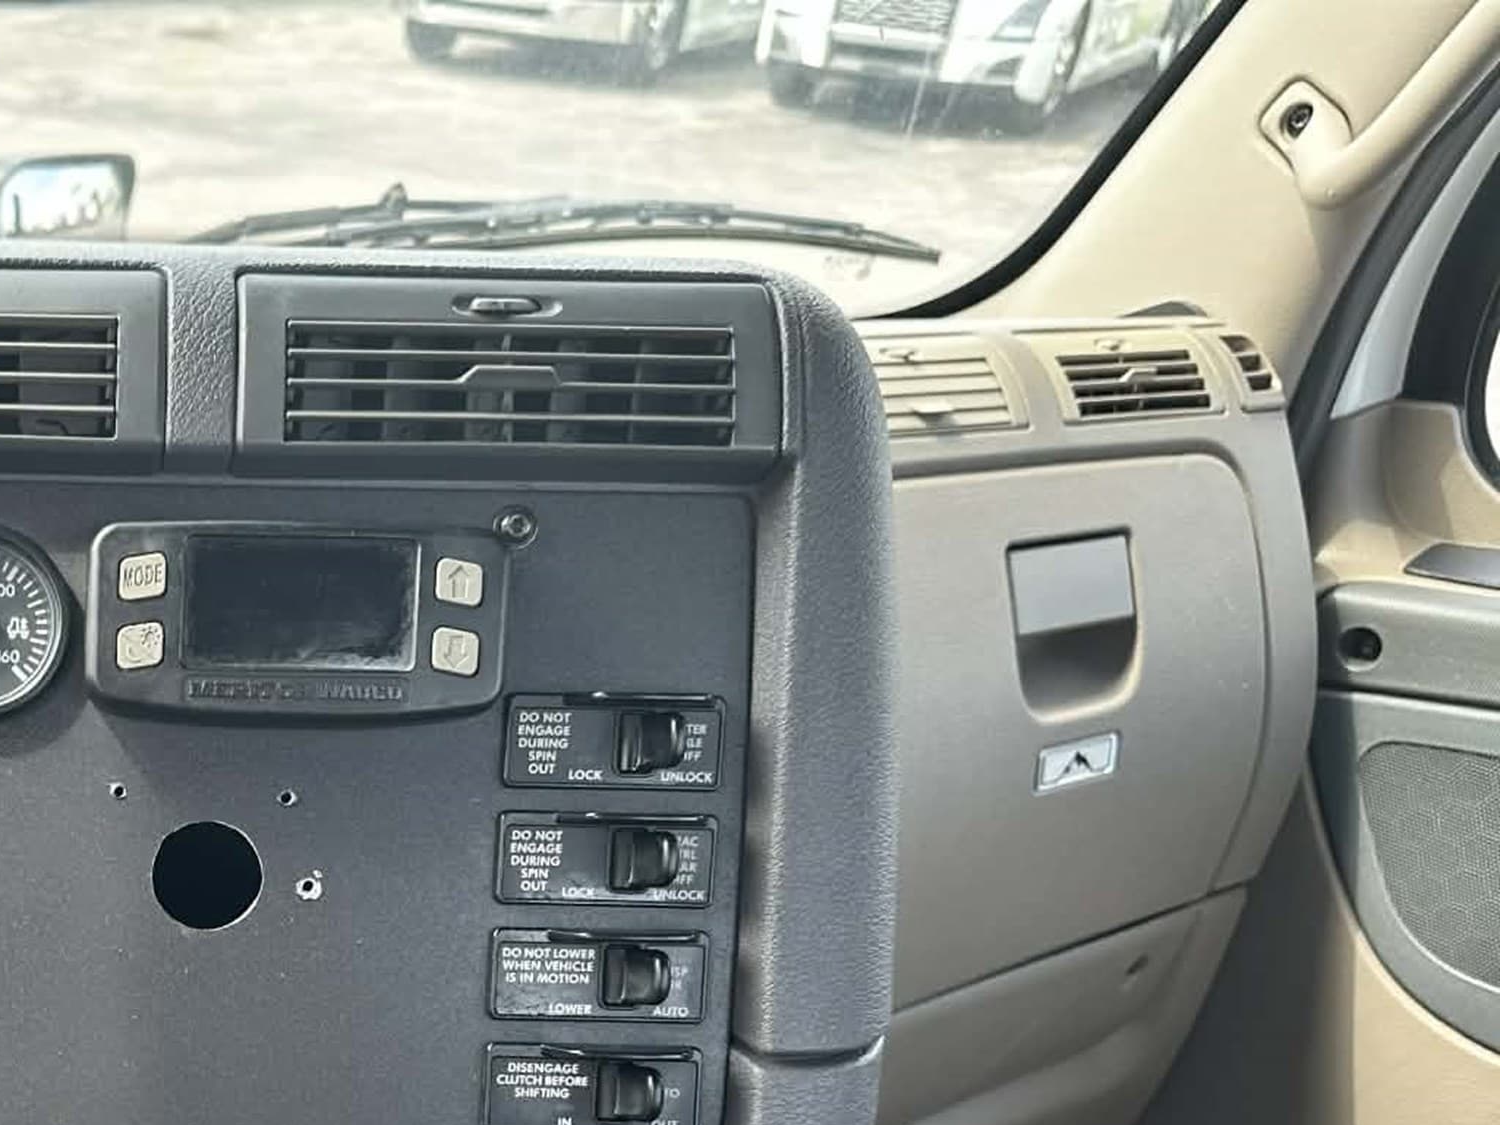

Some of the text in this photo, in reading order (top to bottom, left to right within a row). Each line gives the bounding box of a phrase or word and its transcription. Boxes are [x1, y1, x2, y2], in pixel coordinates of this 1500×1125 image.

[123, 561, 163, 589] MODE
[519, 713, 572, 723] DO NOT
[517, 725, 571, 736] ENGAGE
[518, 738, 569, 749] DURING
[528, 751, 557, 762] SPIN
[528, 764, 557, 774] OUT
[568, 769, 603, 781] LOCK
[661, 772, 713, 783] UNLOCK
[511, 830, 563, 841] DO NOT
[510, 843, 563, 854] ENGAGE
[511, 856, 560, 867] DURING
[521, 868, 549, 878] SPIN
[520, 881, 549, 891] OUT
[562, 887, 596, 898] LOCK
[653, 890, 705, 900] UNLOCK
[502, 947, 596, 960] DO NOT LOWER
[502, 960, 594, 972] WHEN VEHICLE
[505, 973, 589, 984] IS IN MOTION
[549, 1004, 592, 1015] LOWER
[653, 1006, 689, 1017] AUTO
[507, 1063, 579, 1074] DISENGAGE
[496, 1074, 588, 1087] CLUTCH BEFORE
[514, 1087, 570, 1099] SHIFTING
